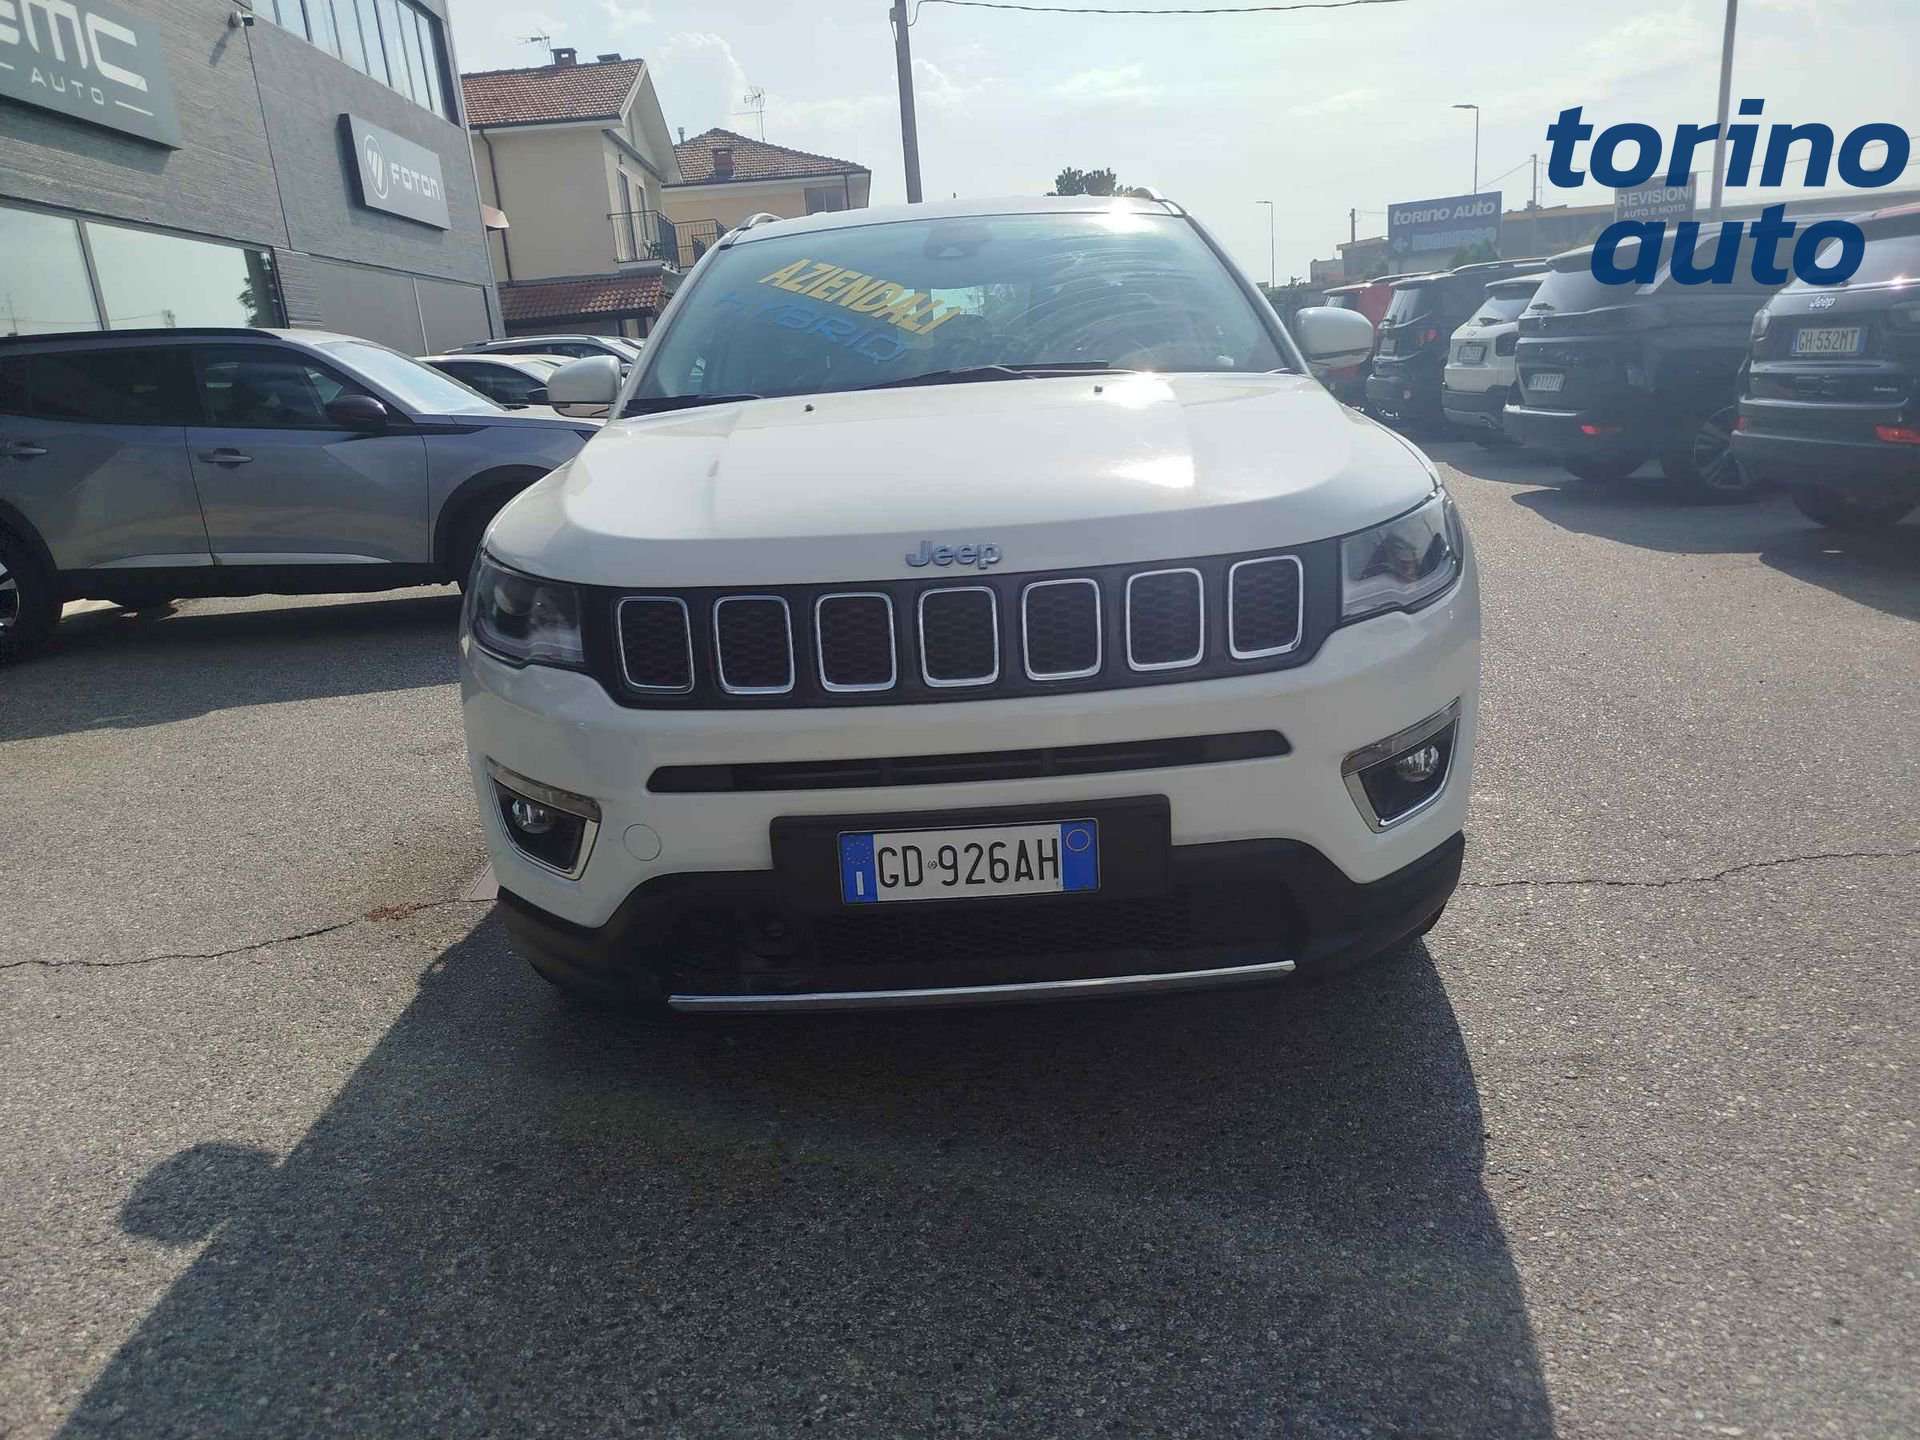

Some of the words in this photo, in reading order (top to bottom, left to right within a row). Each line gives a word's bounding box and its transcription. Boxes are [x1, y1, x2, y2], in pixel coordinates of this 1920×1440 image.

[31, 67, 105, 106] AUTO
[757, 258, 961, 336] AZIENDALI
[905, 541, 1001, 570] Jeep
